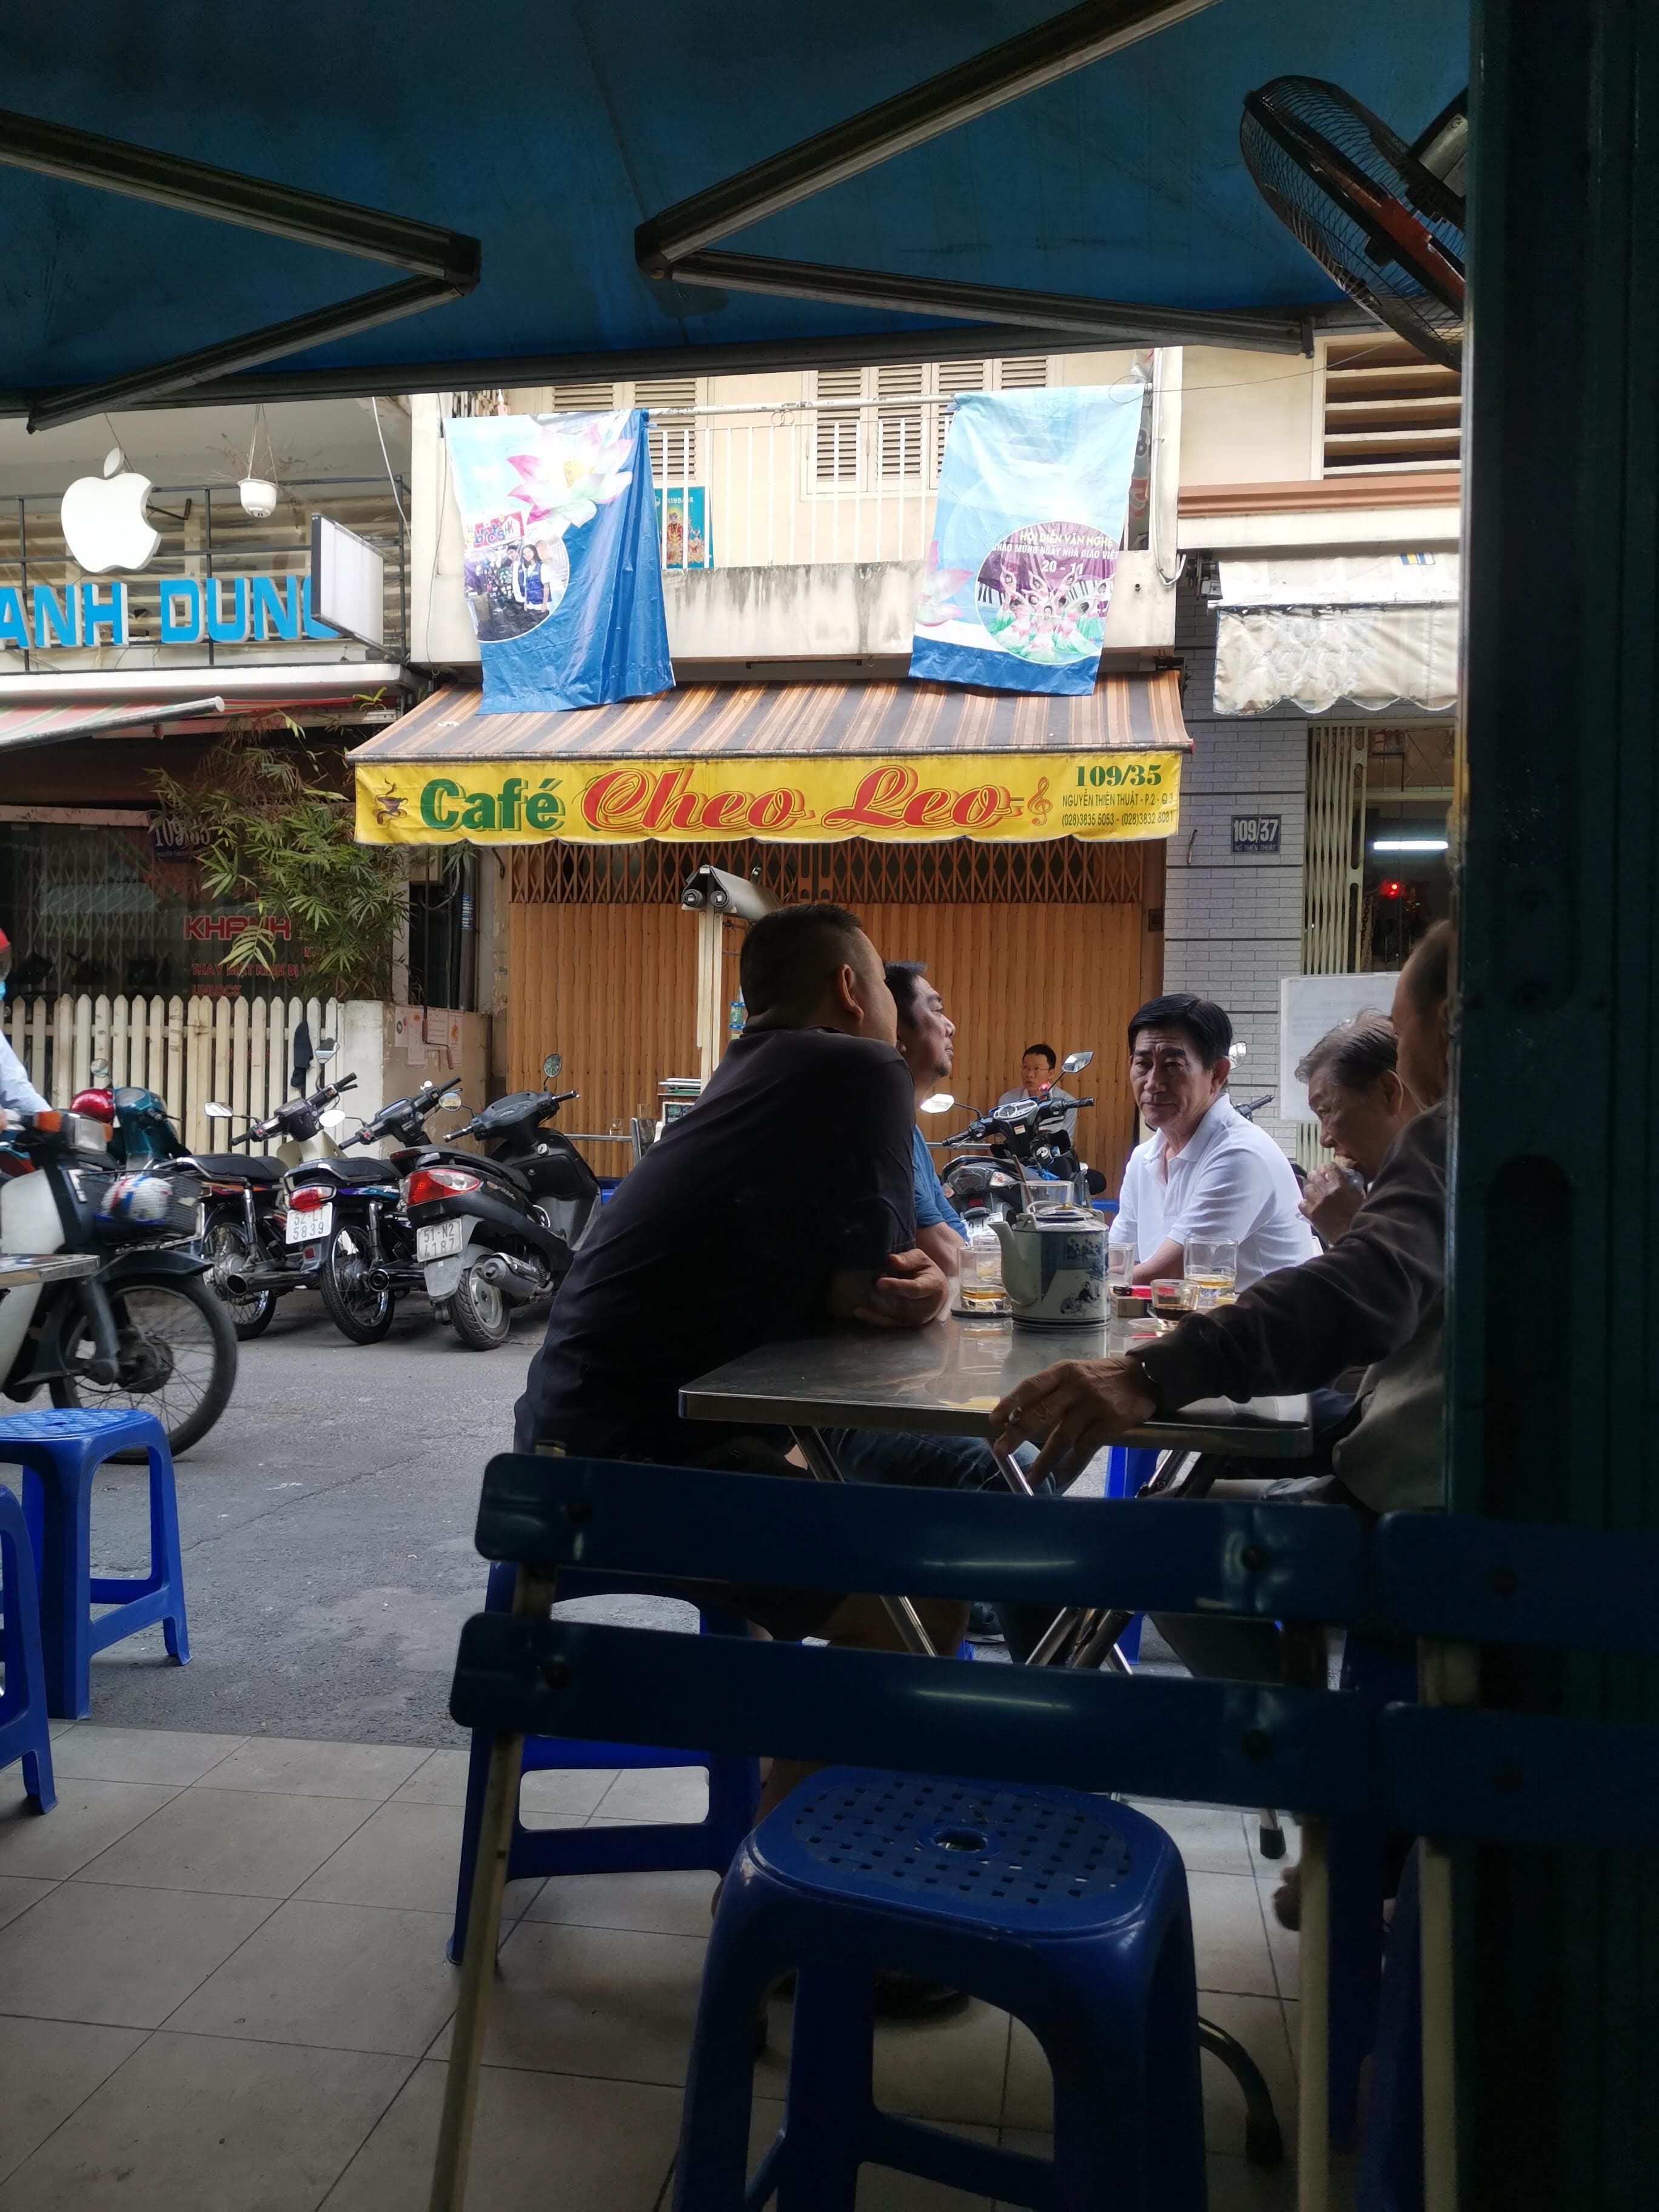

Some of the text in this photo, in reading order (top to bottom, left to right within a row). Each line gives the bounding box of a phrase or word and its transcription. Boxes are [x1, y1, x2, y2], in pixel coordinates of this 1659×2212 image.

[1042, 560, 1057, 573] 20
[0, 582, 125, 649] ANH
[1076, 764, 1162, 786] 109/35
[420, 764, 1016, 833] Café Cheo Leo
[1117, 791, 1138, 808] THUẬT
[1145, 793, 1155, 805] P.2
[1062, 813, 1096, 827] (028)3835
[1098, 813, 1114, 825] 5053
[1122, 813, 1155, 826] (028)3832
[1234, 817, 1278, 843] 109/37
[191, 964, 223, 976] THAY
[191, 984, 243, 997] UNLOCK
[293, 1221, 324, 1240] 5839
[424, 1222, 455, 1243] 51-N2
[424, 1237, 455, 1257] 4187
